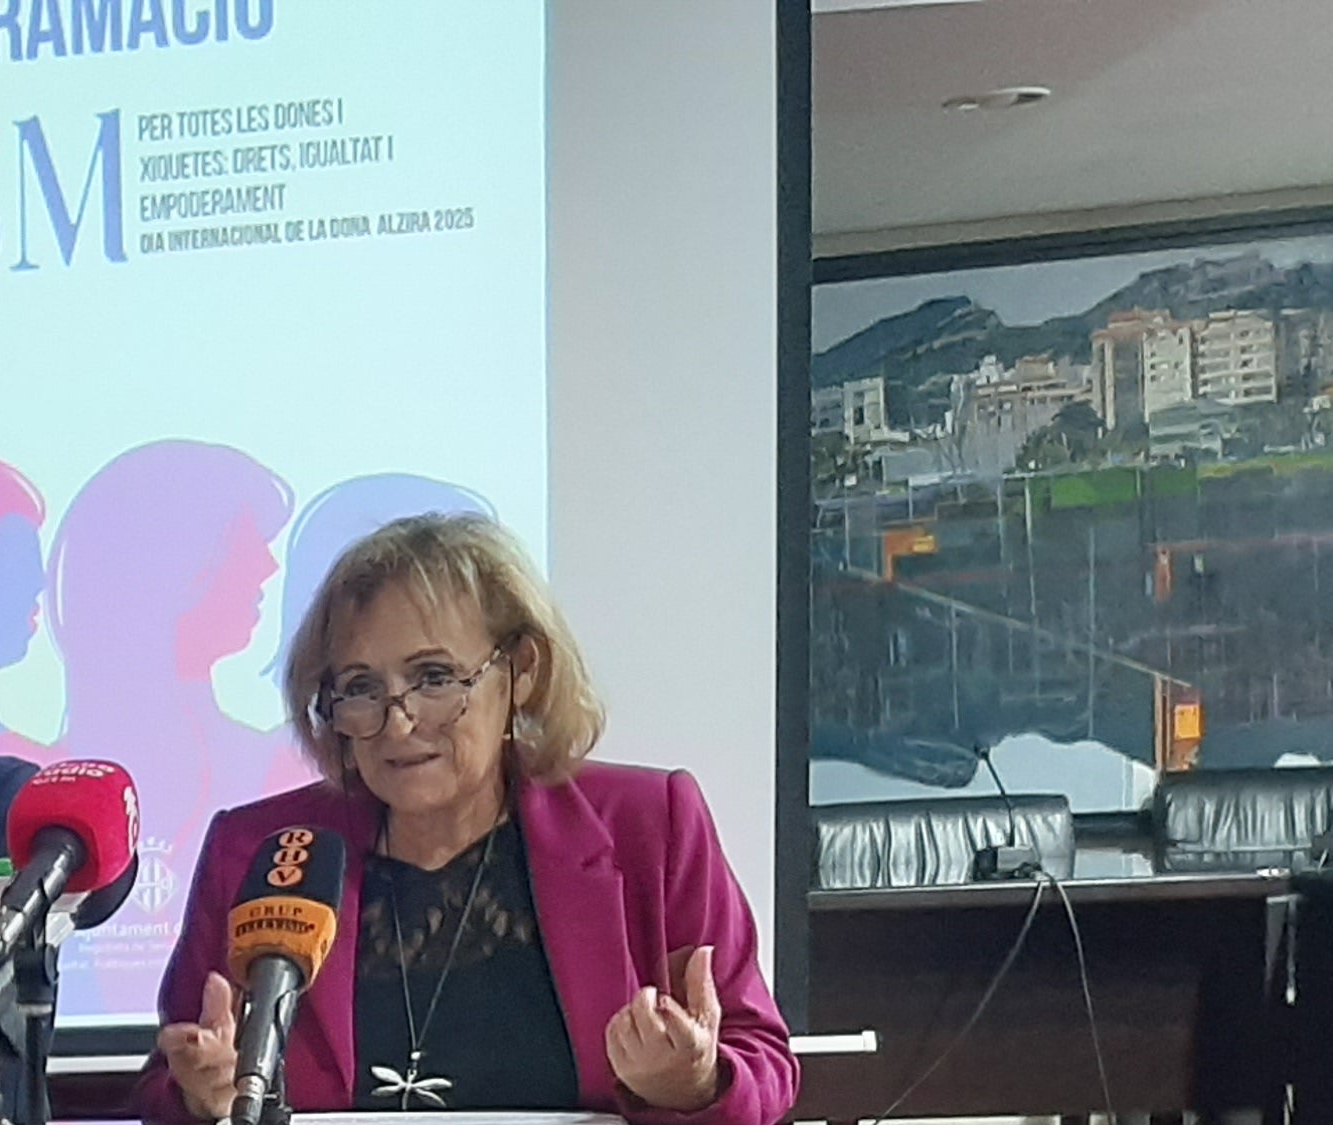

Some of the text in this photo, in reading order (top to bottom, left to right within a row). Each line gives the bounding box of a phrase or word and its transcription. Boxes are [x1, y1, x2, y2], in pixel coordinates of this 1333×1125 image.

[138, 113, 173, 142] PER
[178, 108, 233, 138] TOTES
[236, 104, 269, 134] LES
[273, 99, 334, 130] DONES
[139, 149, 228, 183] XIQUETES:
[232, 143, 296, 174] DRETS,
[299, 136, 383, 170] IGUALTAT
[140, 183, 286, 222] EMPODERAMENT
[139, 206, 474, 254] DIA INTERNACIONAL DE LA DONA ALZIRA 2025
